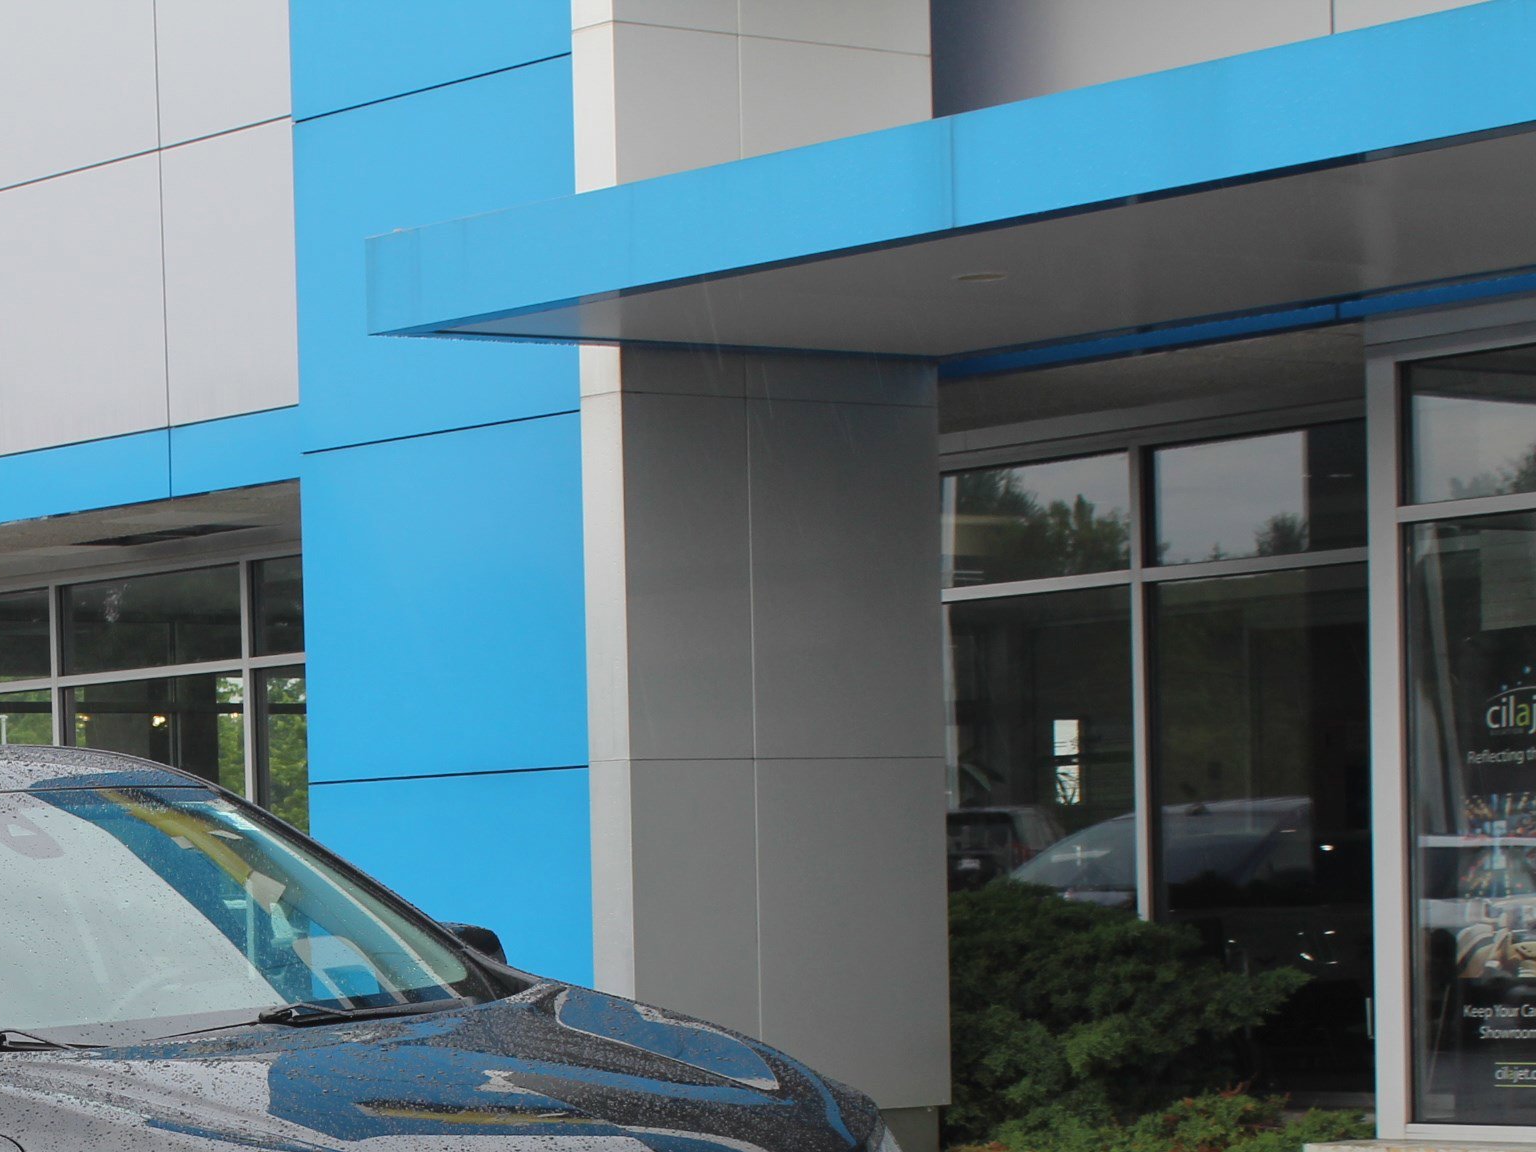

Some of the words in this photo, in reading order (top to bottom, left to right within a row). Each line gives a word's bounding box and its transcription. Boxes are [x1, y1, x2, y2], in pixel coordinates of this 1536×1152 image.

[1467, 749, 1525, 764] Reflecting
[1463, 1004, 1493, 1020] Keep
[1493, 1004, 1520, 1017] Your
